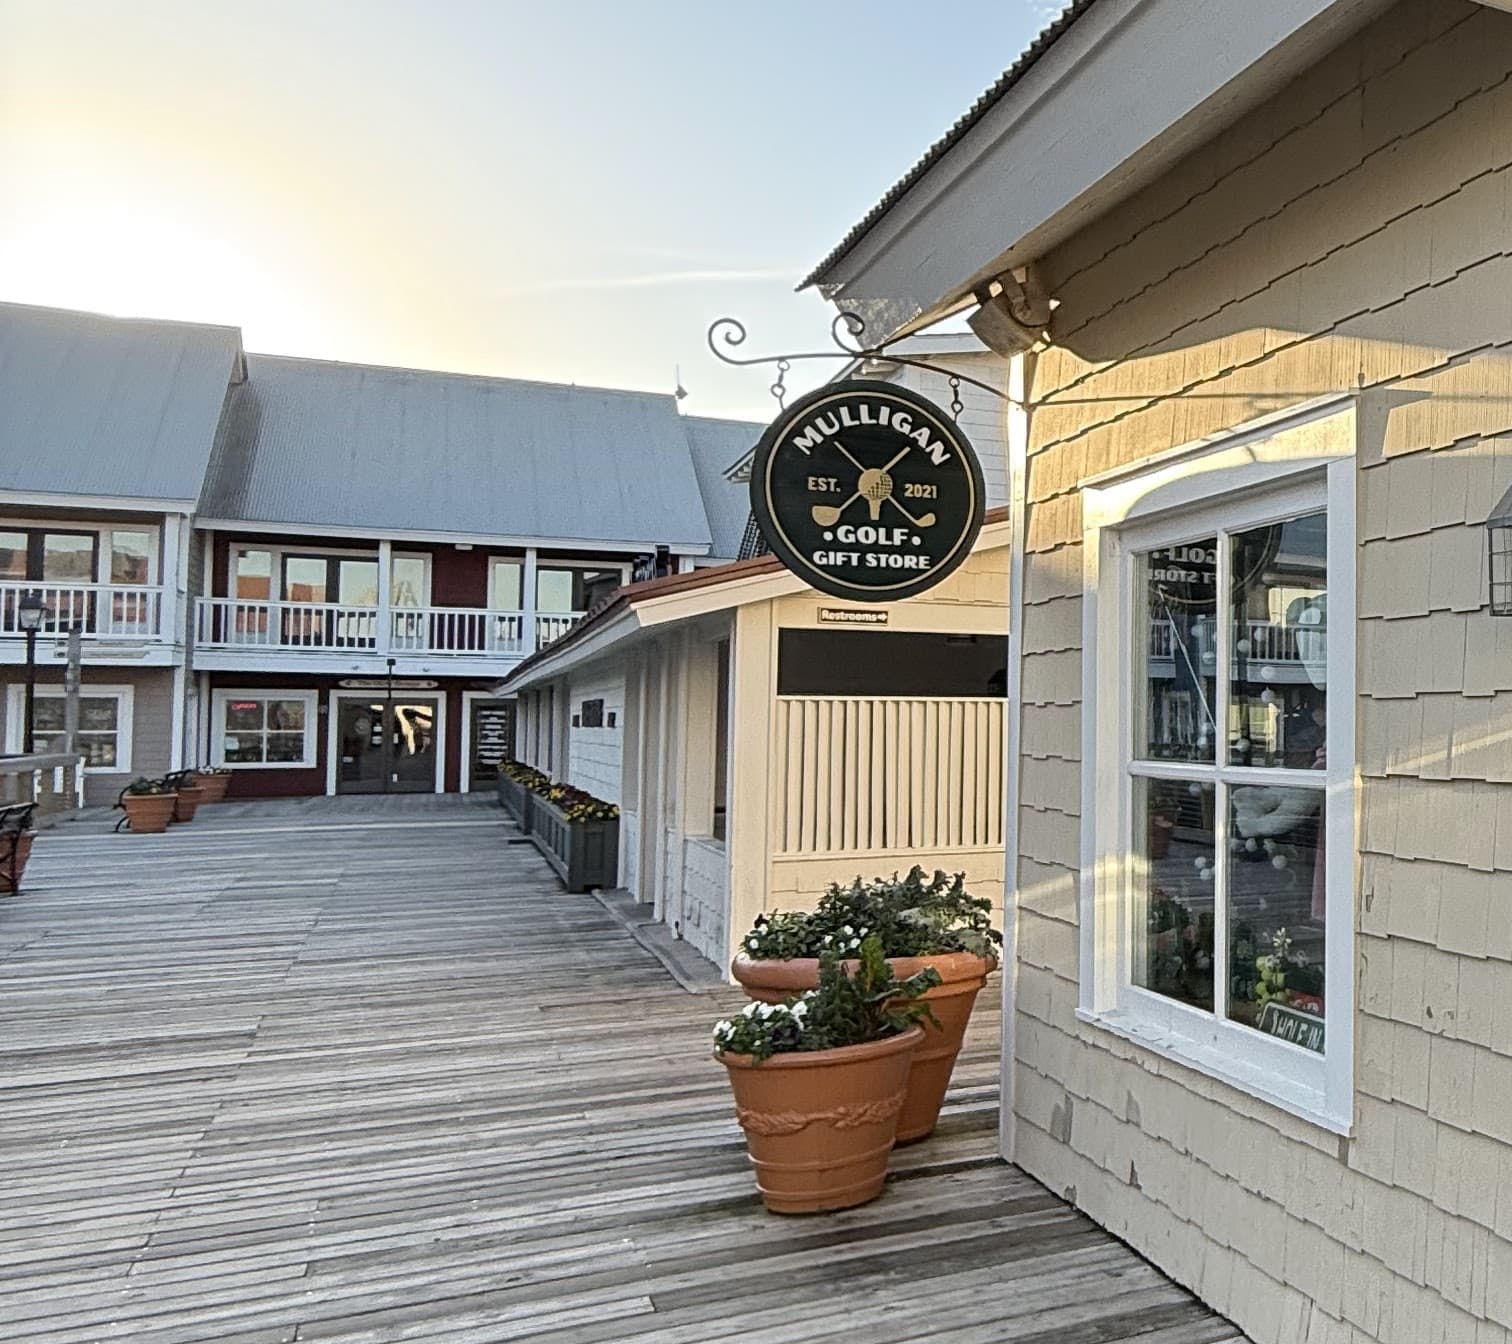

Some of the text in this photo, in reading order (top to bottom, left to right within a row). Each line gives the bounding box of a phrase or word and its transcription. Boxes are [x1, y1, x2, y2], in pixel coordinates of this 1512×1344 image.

[793, 404, 951, 466] MULLIGAN
[807, 476, 938, 500] EST. 2021
[836, 524, 910, 546] GOLF
[812, 550, 932, 570] GIFT STORE
[821, 609, 878, 622] Restrooms
